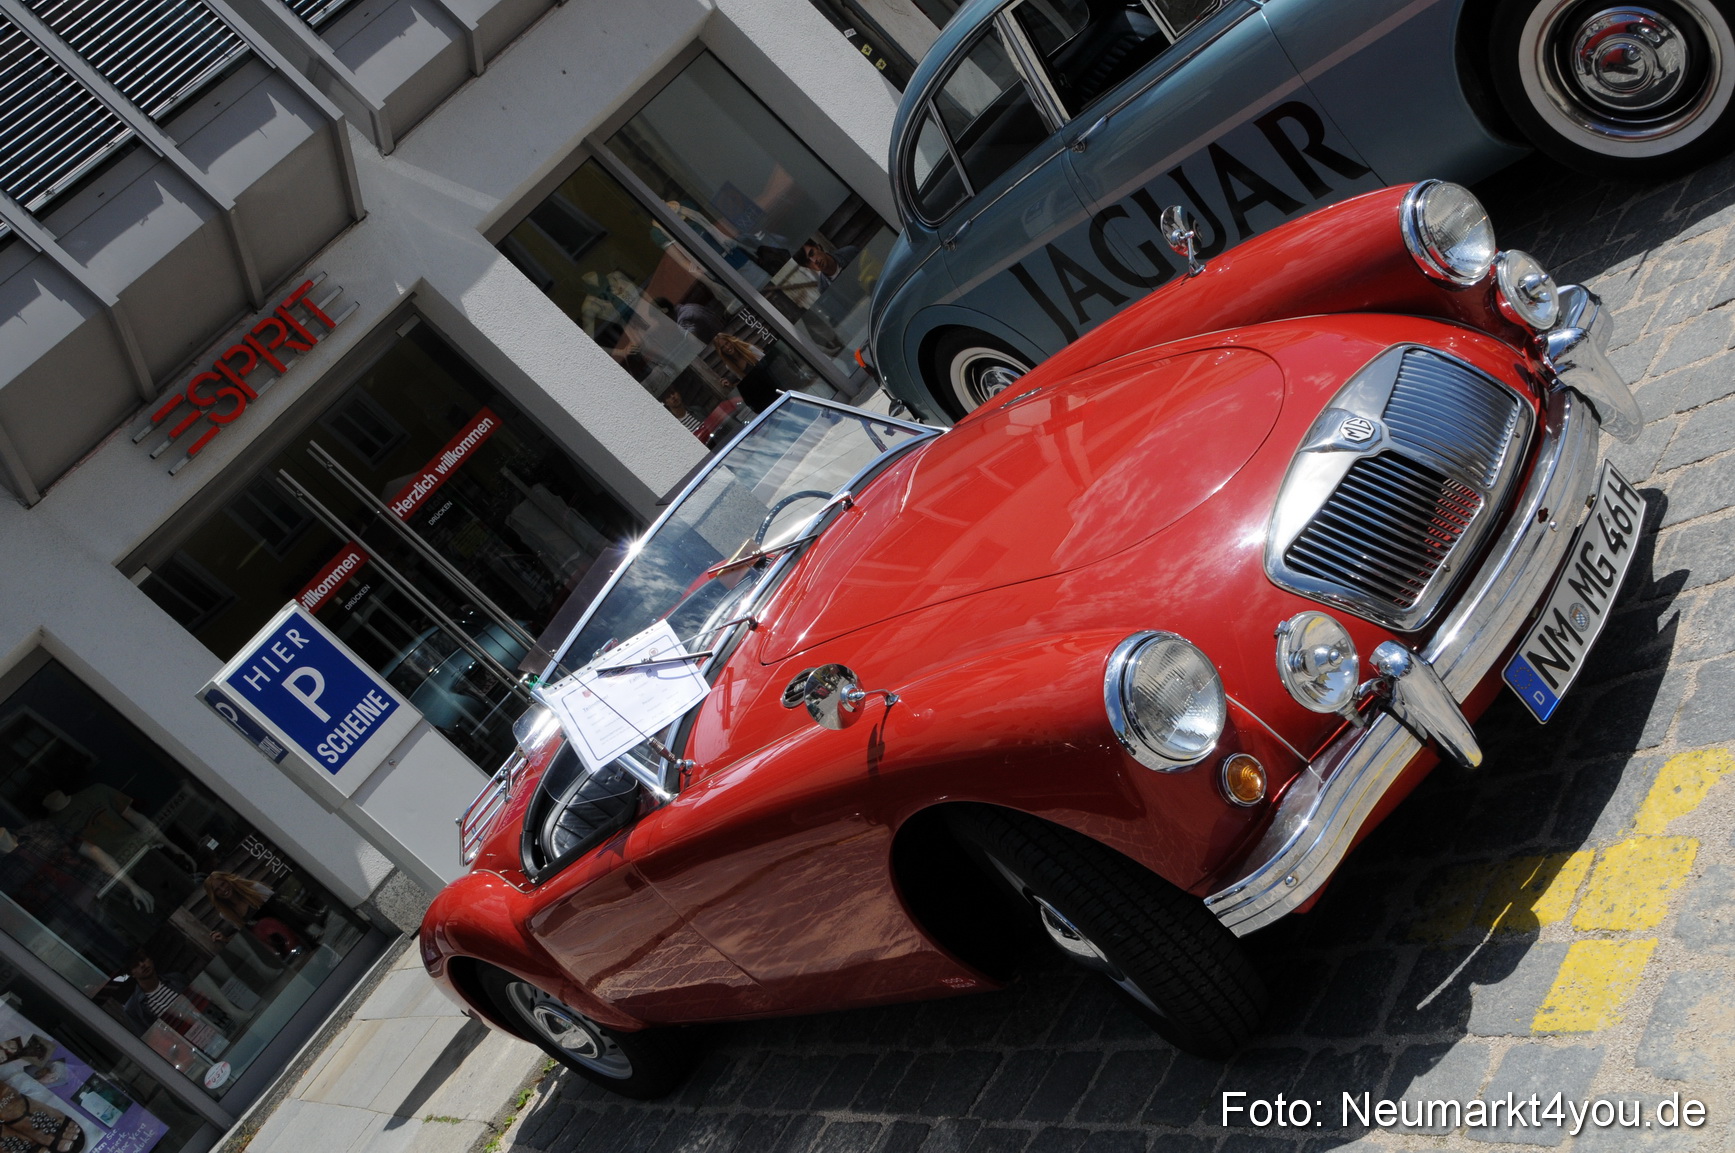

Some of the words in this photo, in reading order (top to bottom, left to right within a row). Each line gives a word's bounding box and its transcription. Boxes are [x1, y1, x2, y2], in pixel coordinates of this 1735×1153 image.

[1008, 101, 1371, 344] JAGUAR
[738, 308, 778, 344] ESPRIT
[151, 280, 336, 455] ESPRIT
[1342, 418, 1372, 440] MG
[392, 472, 438, 517] Herzlich
[435, 416, 494, 475] willkommen
[428, 500, 453, 526] DRÜCKEN
[344, 584, 371, 611] DRÜCKEN
[1526, 607, 1584, 690] NM
[1568, 541, 1617, 616] MG
[1597, 468, 1640, 551] 46H
[243, 628, 310, 692] HIER
[215, 701, 249, 735] P
[281, 666, 331, 724] P
[1533, 690, 1545, 706] D
[316, 689, 390, 764] SCHEINE
[241, 834, 293, 878] ESPRIT
